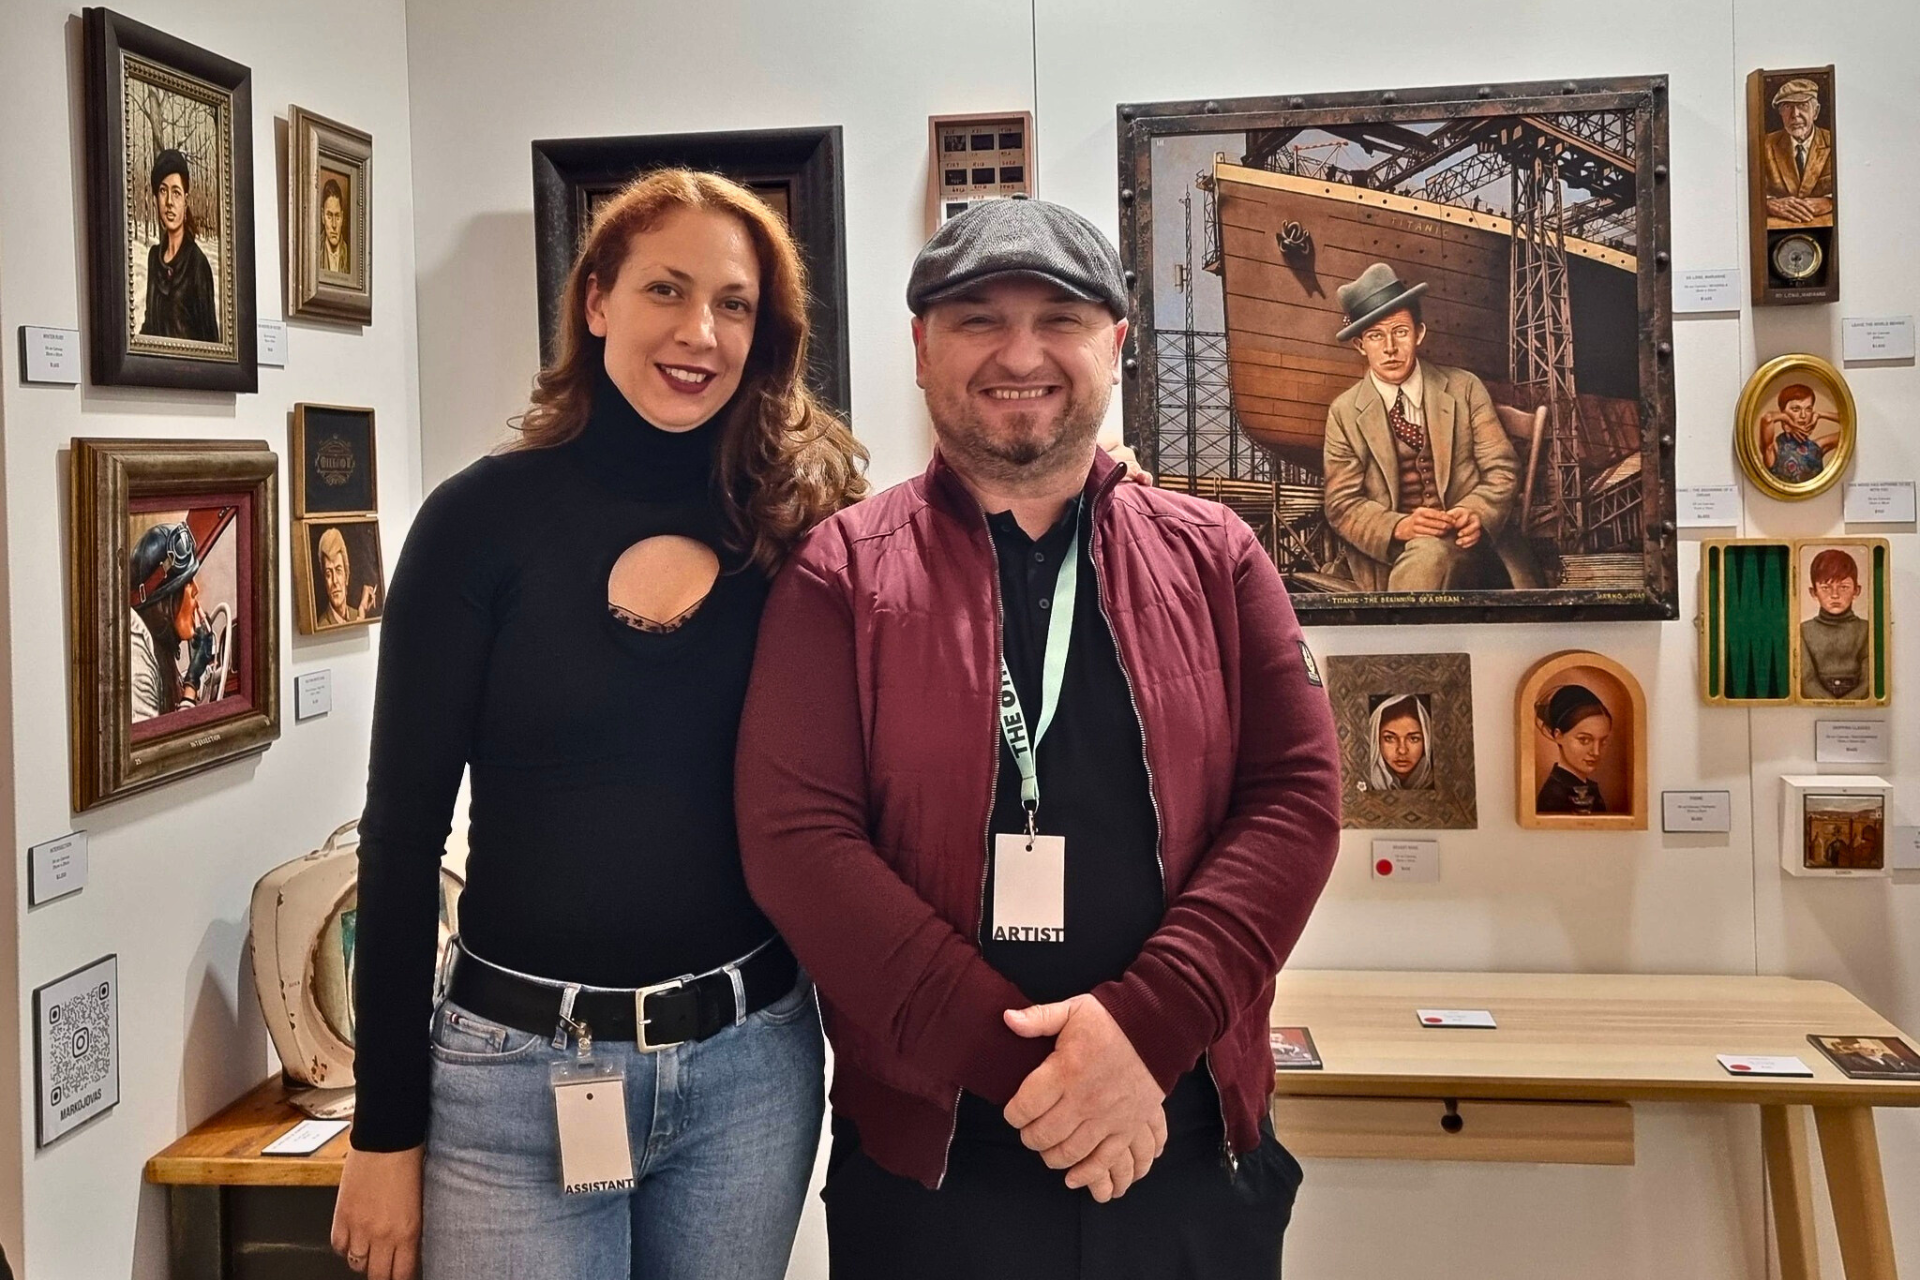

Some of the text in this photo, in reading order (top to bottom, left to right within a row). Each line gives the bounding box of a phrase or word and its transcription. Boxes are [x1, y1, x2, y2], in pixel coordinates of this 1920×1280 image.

[1391, 217, 1449, 236] TITANIC
[1332, 596, 1359, 604] TITANIC
[1003, 711, 1028, 759] THE
[994, 926, 1064, 942] ARTIST
[60, 1088, 102, 1121] MARKOJOVAS
[565, 1178, 634, 1195] ASSISTANT
